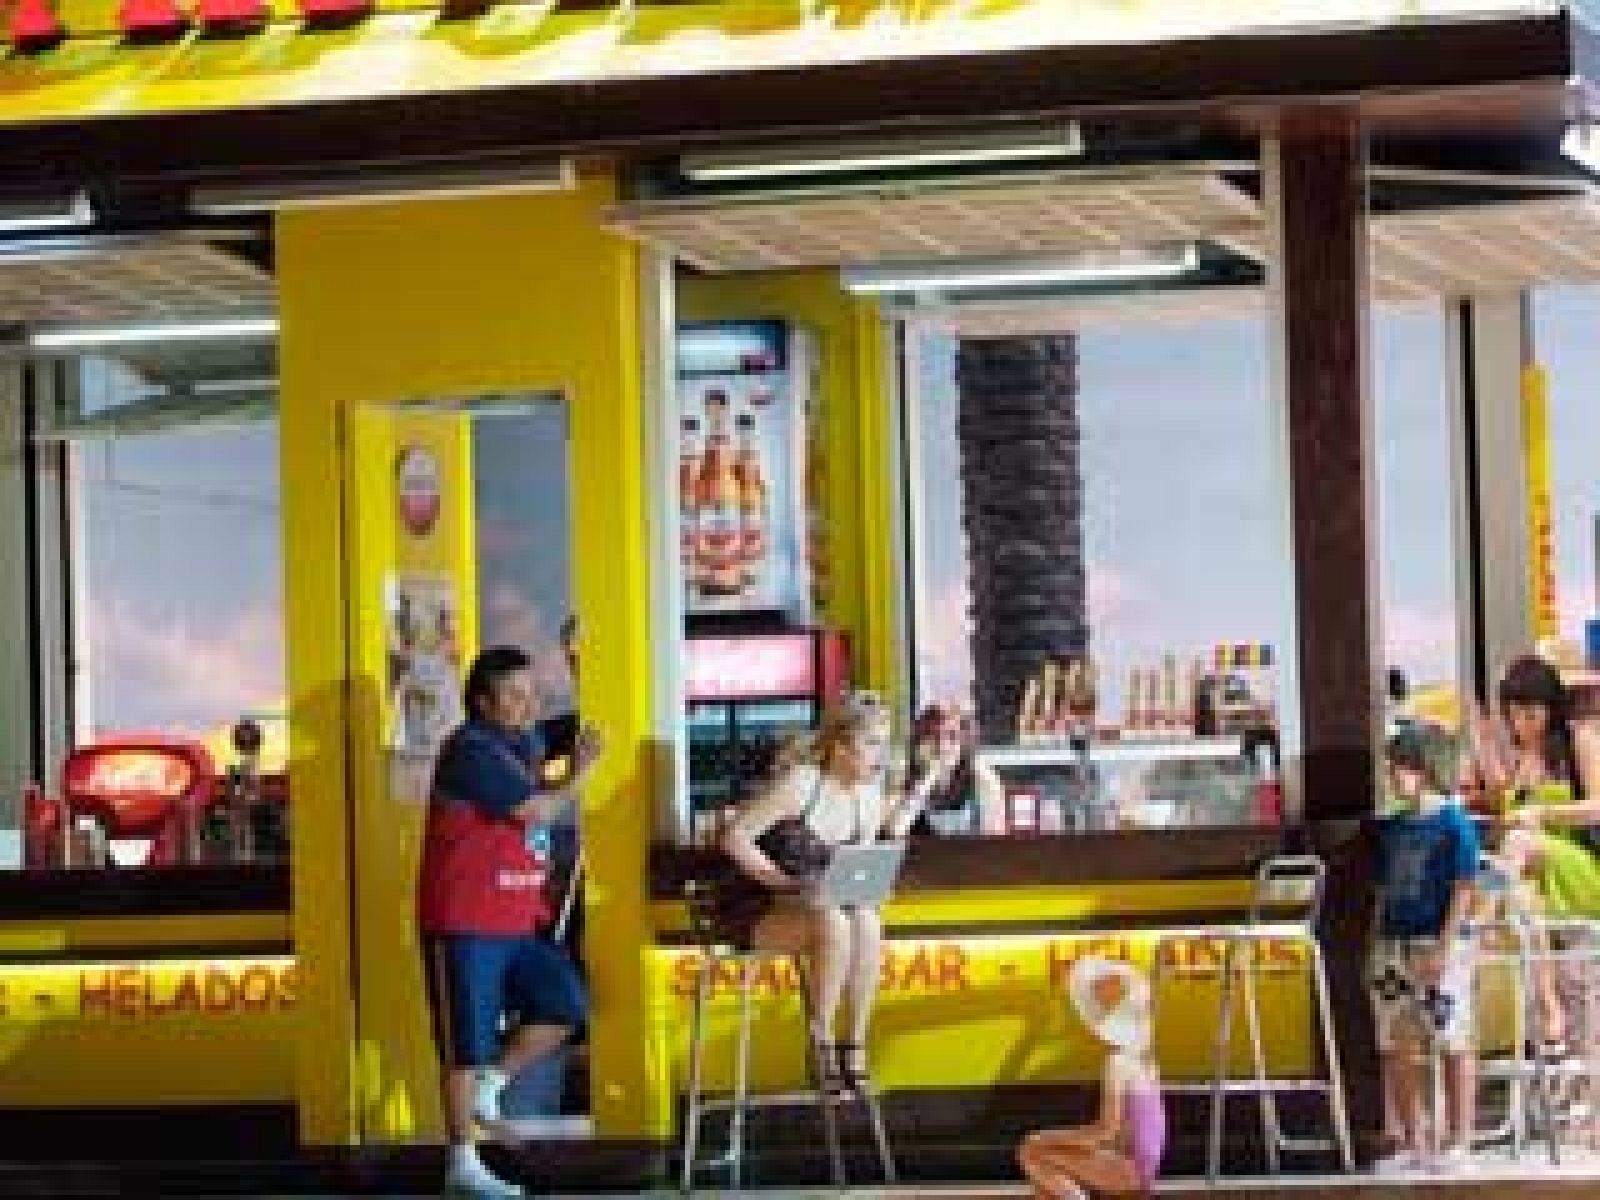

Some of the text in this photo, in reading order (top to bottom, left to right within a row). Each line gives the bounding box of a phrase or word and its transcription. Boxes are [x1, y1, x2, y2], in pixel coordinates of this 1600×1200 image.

[79, 961, 306, 1017] HELADOS
[672, 952, 804, 1000] SNAC
[880, 942, 970, 993] BAR
